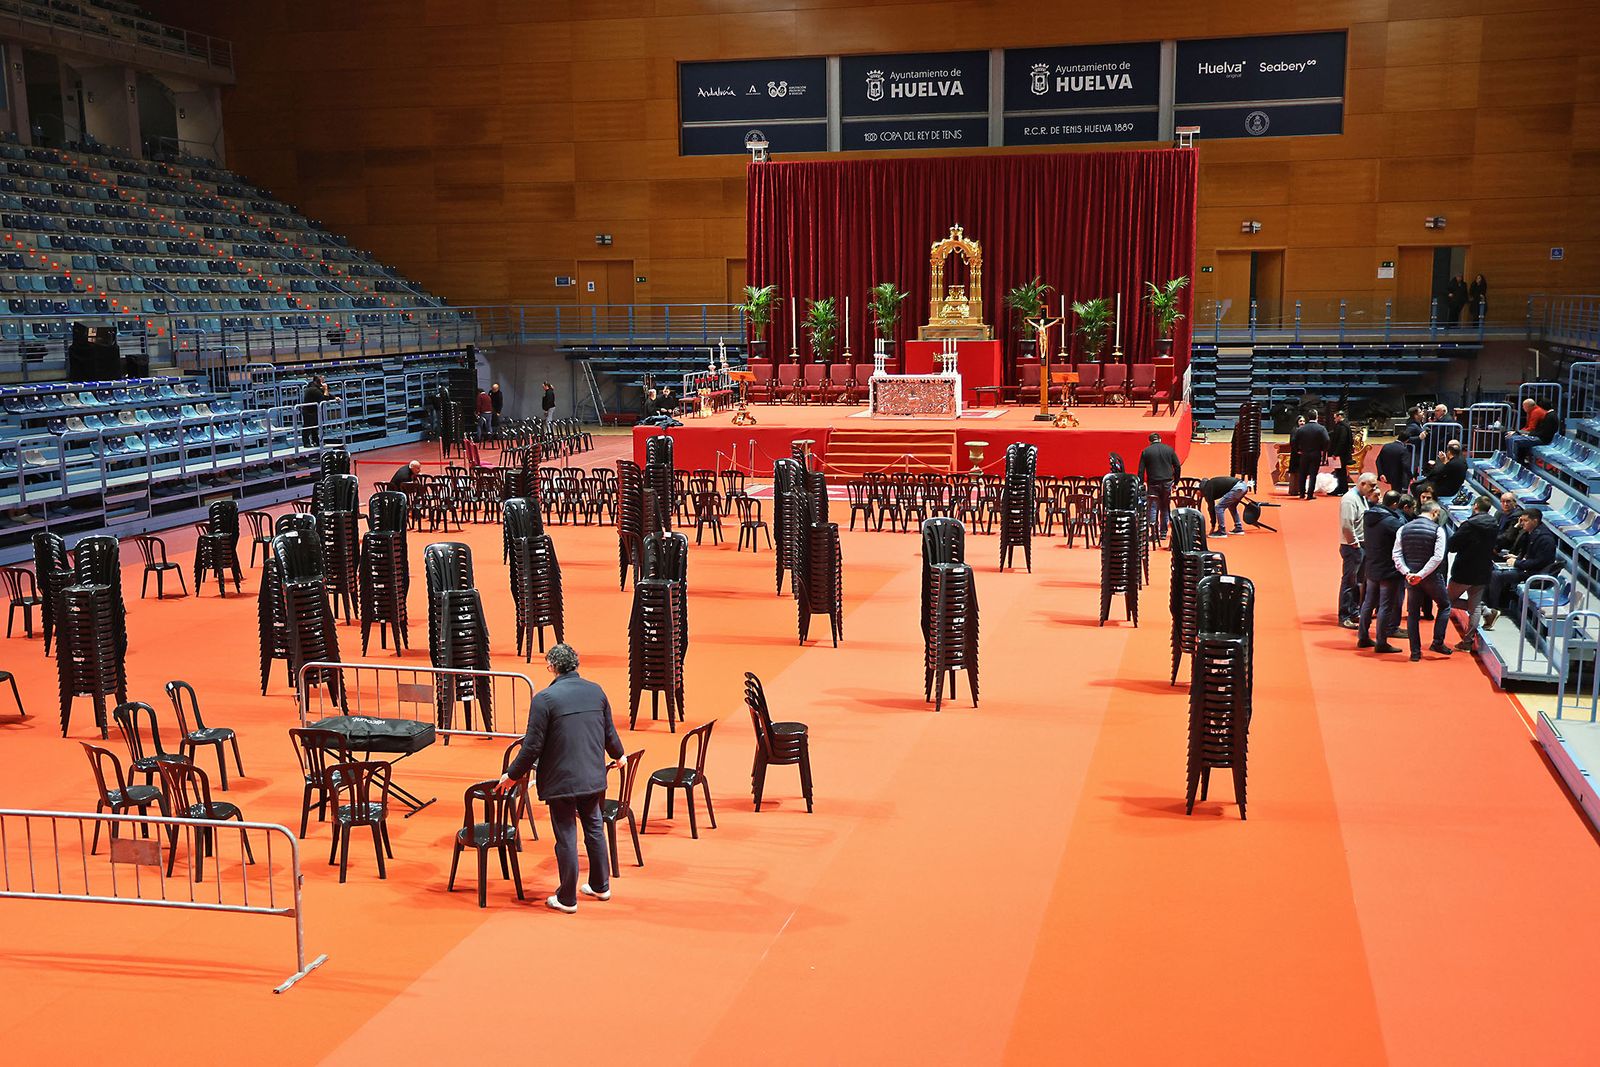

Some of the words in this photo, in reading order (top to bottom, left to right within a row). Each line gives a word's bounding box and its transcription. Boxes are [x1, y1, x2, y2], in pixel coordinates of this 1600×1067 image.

[1055, 62, 1117, 75] Ayuntamiento
[1119, 61, 1131, 70] de
[1198, 61, 1242, 74] Huelva
[1259, 62, 1306, 73] Seabery
[890, 69, 949, 81] Ayuntamiento
[950, 68, 962, 77] de
[891, 81, 964, 98] HUELVA
[1056, 74, 1133, 92] HUELVA
[880, 131, 903, 142] COPA
[903, 131, 916, 141] DEL
[917, 130, 931, 140] REY
[931, 130, 940, 140] DE
[941, 129, 962, 140] TENIS
[1024, 126, 1048, 135] R.C.R.
[1050, 126, 1060, 135] DE
[1062, 125, 1082, 134] TENIS
[1084, 124, 1112, 133] HUELVA
[1114, 123, 1134, 132] 1889
